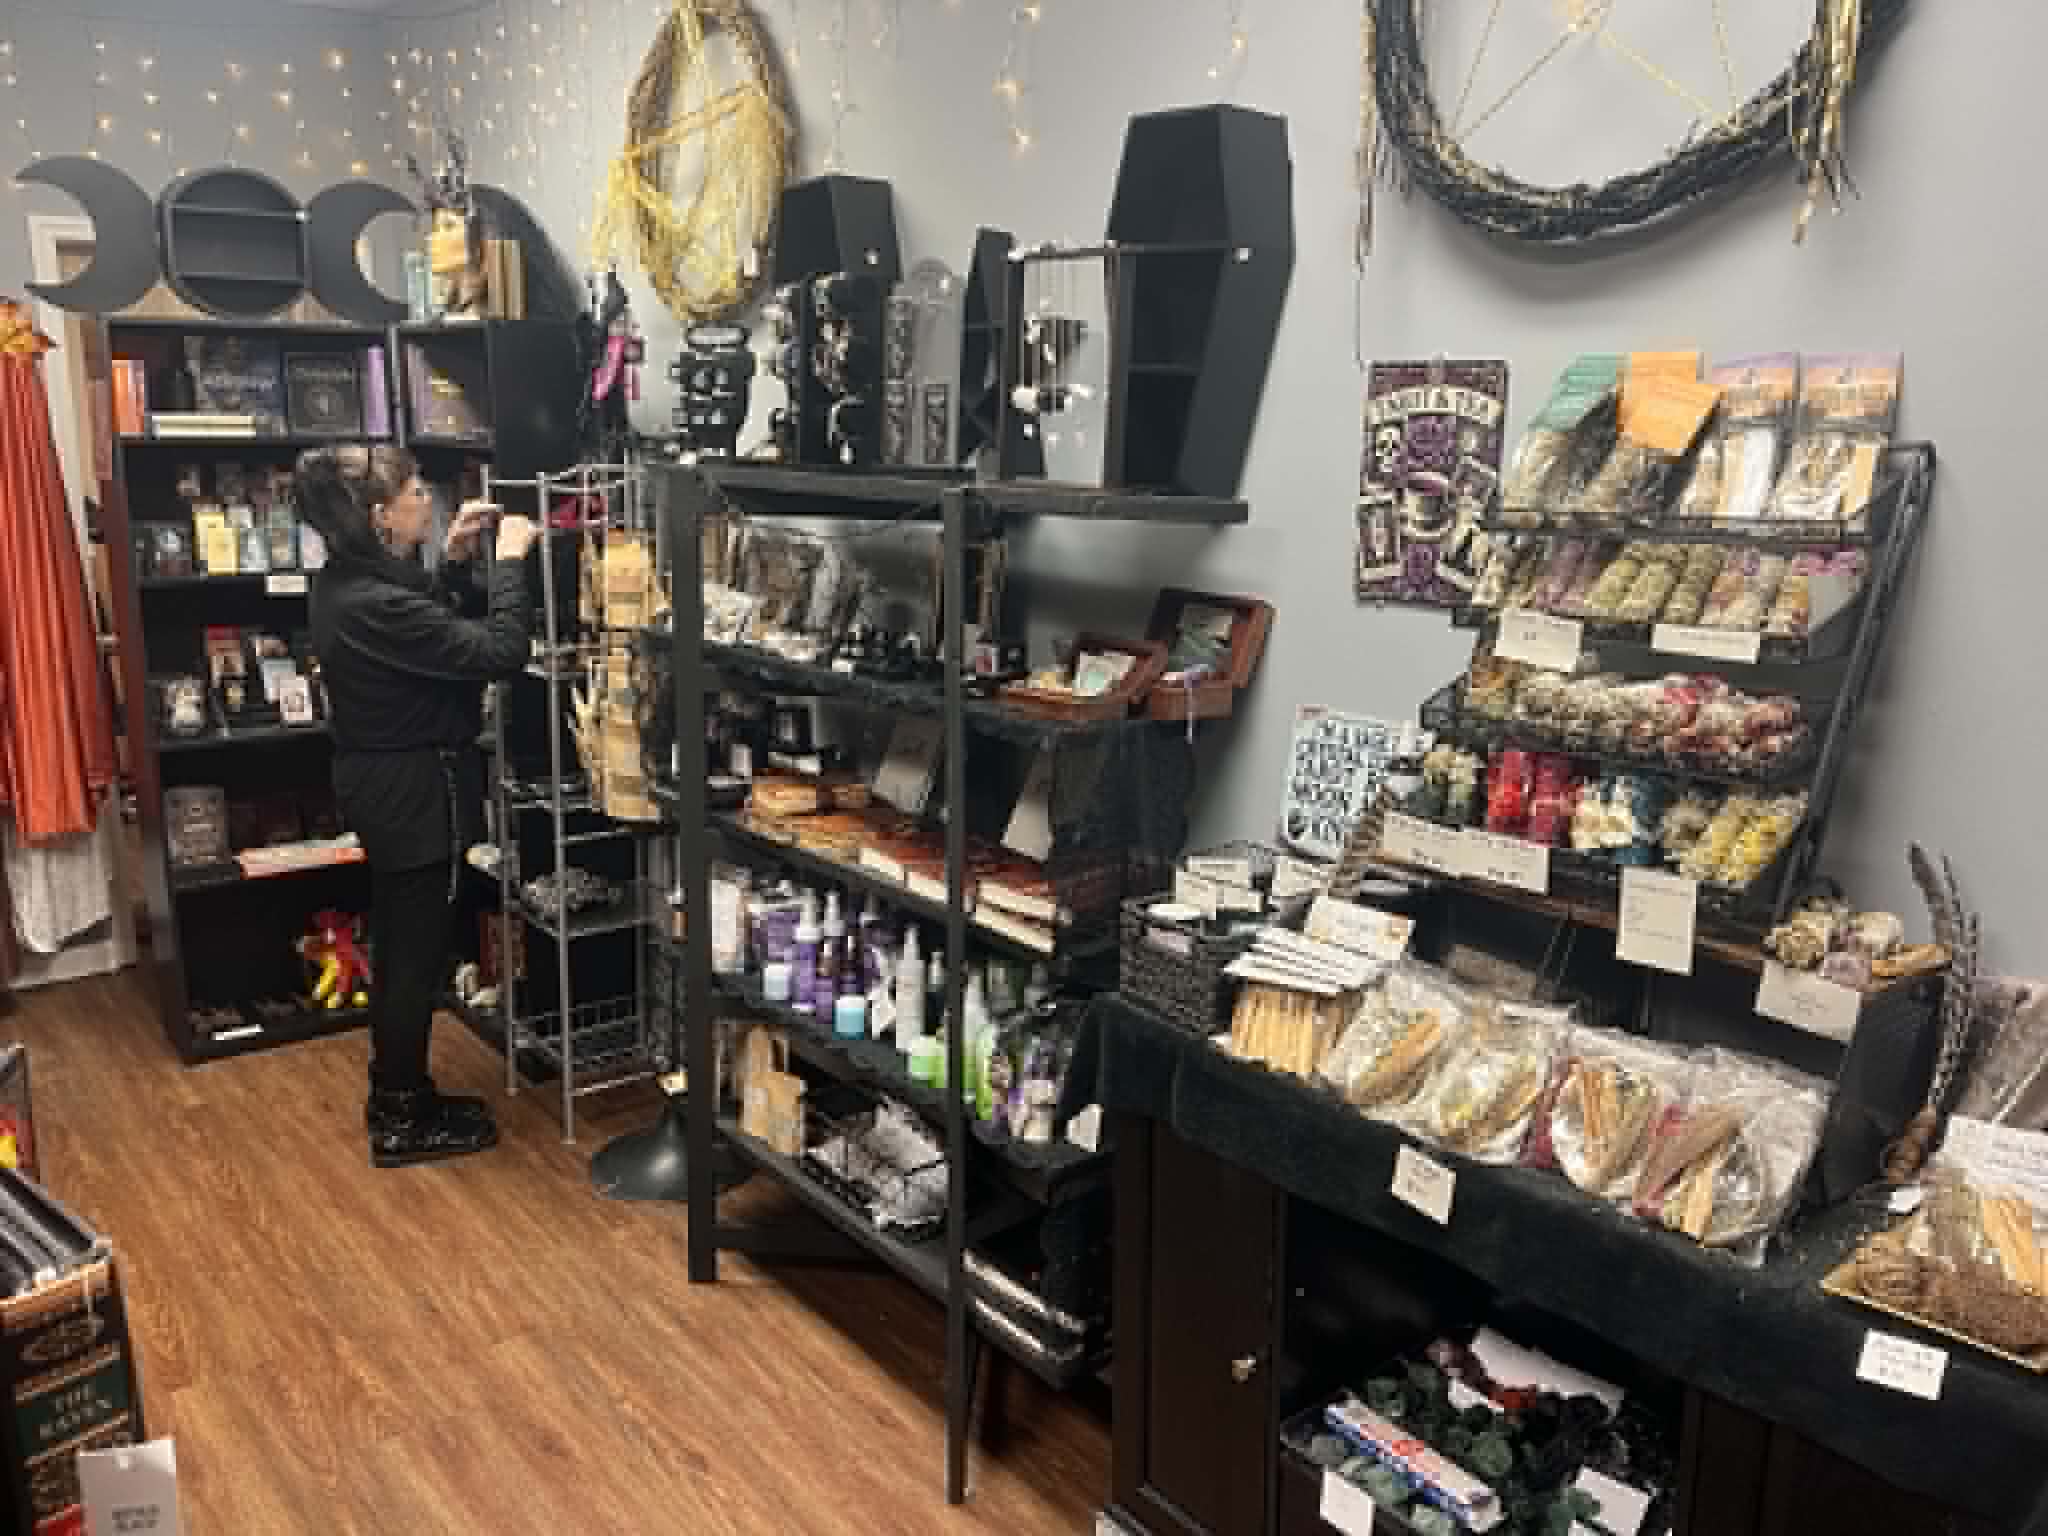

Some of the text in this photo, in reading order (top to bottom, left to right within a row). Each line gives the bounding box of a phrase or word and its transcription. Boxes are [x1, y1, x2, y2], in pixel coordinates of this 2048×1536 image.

[1376, 389, 1489, 417] TAROT & TEA
[54, 1383, 95, 1411] THE
[39, 1397, 113, 1438] RAVEN
